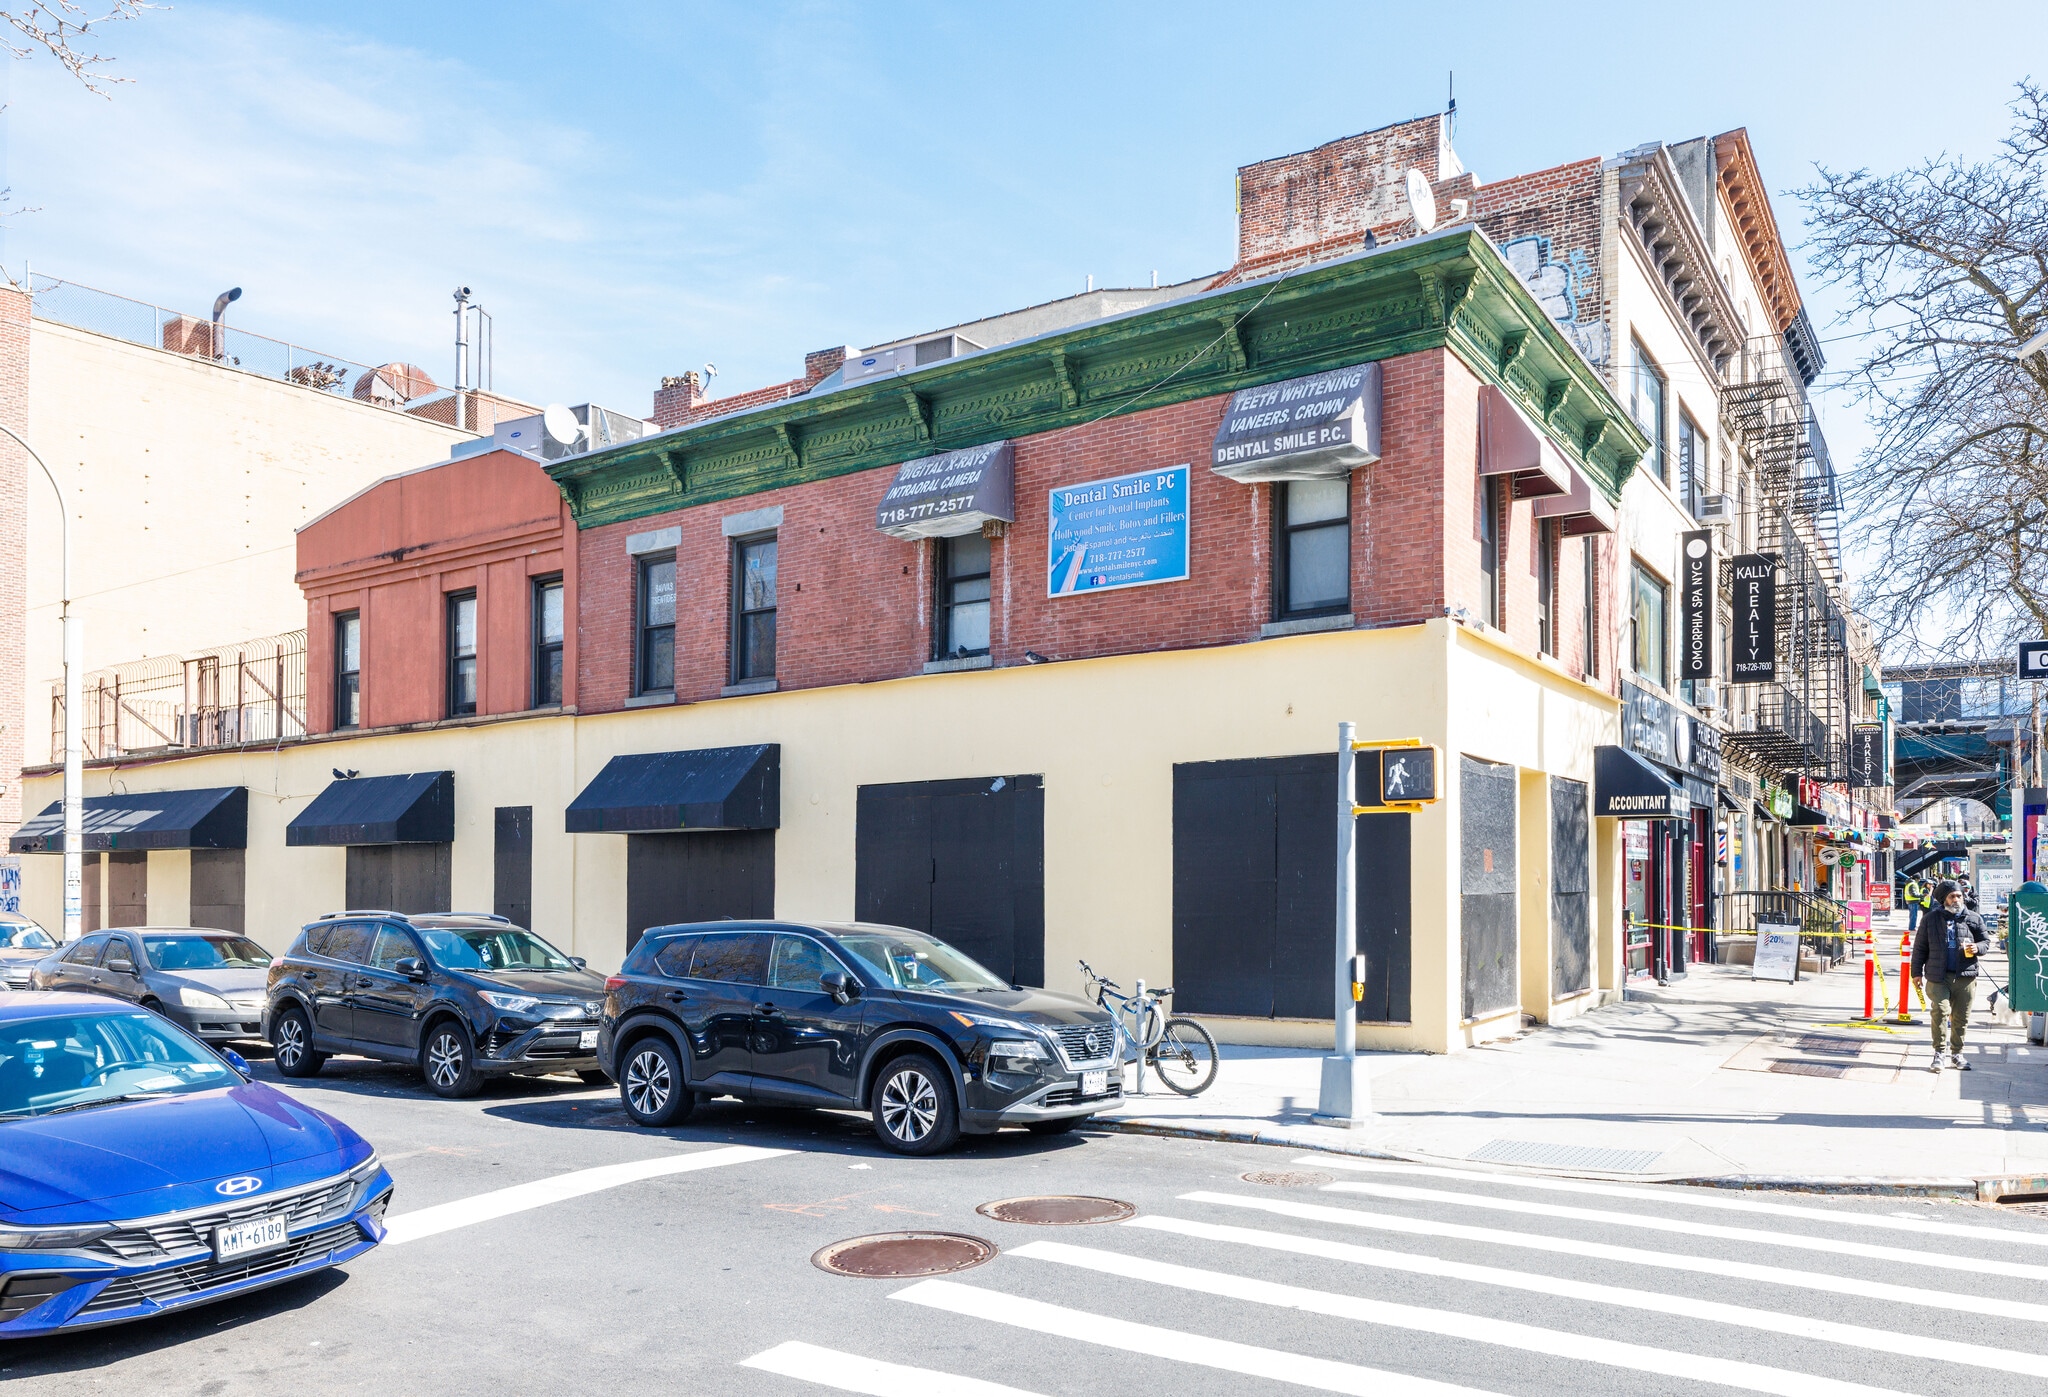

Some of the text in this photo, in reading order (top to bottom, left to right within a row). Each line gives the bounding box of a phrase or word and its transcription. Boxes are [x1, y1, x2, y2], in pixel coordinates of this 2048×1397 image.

[1234, 373, 1362, 412] TEETH WHITENING
[1295, 398, 1346, 421] CROWN
[1218, 426, 1346, 462] DENTAL SMILE P.C.
[900, 452, 988, 482] DIGITAL X-RAYS
[886, 470, 982, 500] INTRAORAL CAMERA
[1064, 474, 1174, 506] Dental Smile PC
[880, 495, 974, 524] 718-777-2577
[1068, 497, 1169, 522] Center for Dental Implants
[1054, 526, 1092, 541] Hollywood
[1120, 520, 1140, 531] Botox
[1144, 514, 1158, 526] and
[1160, 512, 1184, 524] Fillers
[1114, 536, 1126, 546] and
[1079, 558, 1158, 574] www.dentalsmilenyc.com
[1090, 548, 1146, 563] 718-777-2577
[1108, 571, 1144, 582] dentalsmile
[1736, 564, 1772, 580] KALLY
[1692, 562, 1702, 670] OMORPHIA SPA NYC
[1749, 582, 1760, 660] REALTY
[1736, 661, 1772, 672] 718-726-7600
[1608, 796, 1666, 810] ACCOUNTANT
[1770, 936, 1784, 944] 20%
[251, 1219, 268, 1228] YORK
